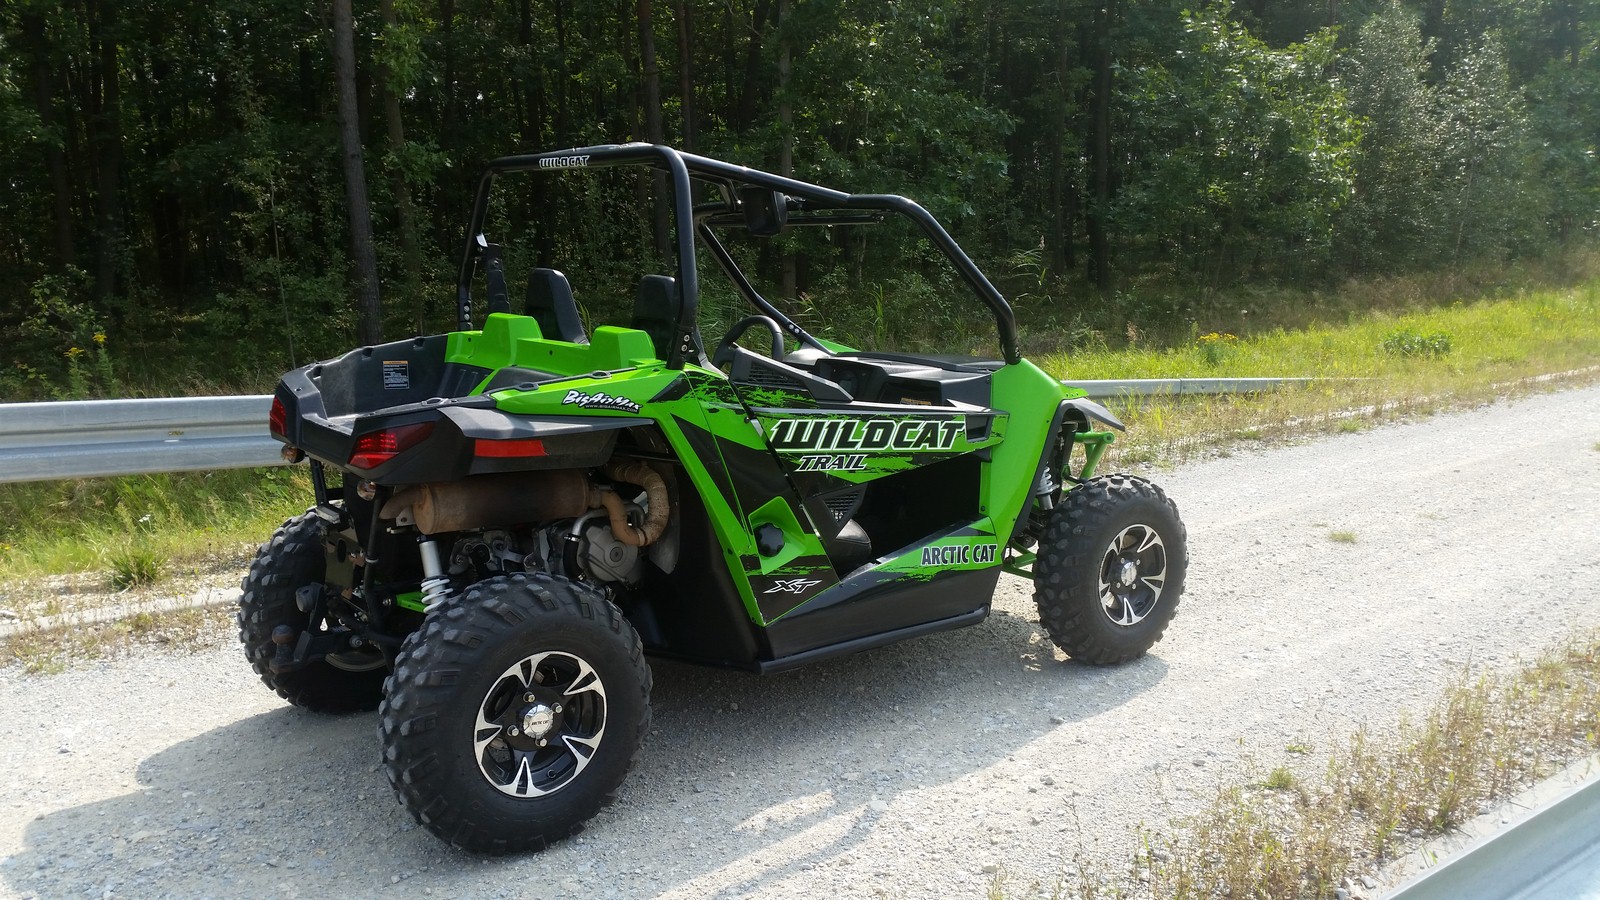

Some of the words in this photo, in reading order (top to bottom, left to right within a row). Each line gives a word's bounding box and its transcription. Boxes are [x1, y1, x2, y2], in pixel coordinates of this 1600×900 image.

[539, 155, 590, 169] WILDCAT
[770, 419, 965, 451] WILDCAT
[795, 454, 868, 472] TRAIL
[921, 545, 969, 566] ARCTIC
[972, 544, 997, 563] CAT
[763, 579, 822, 594] XT
